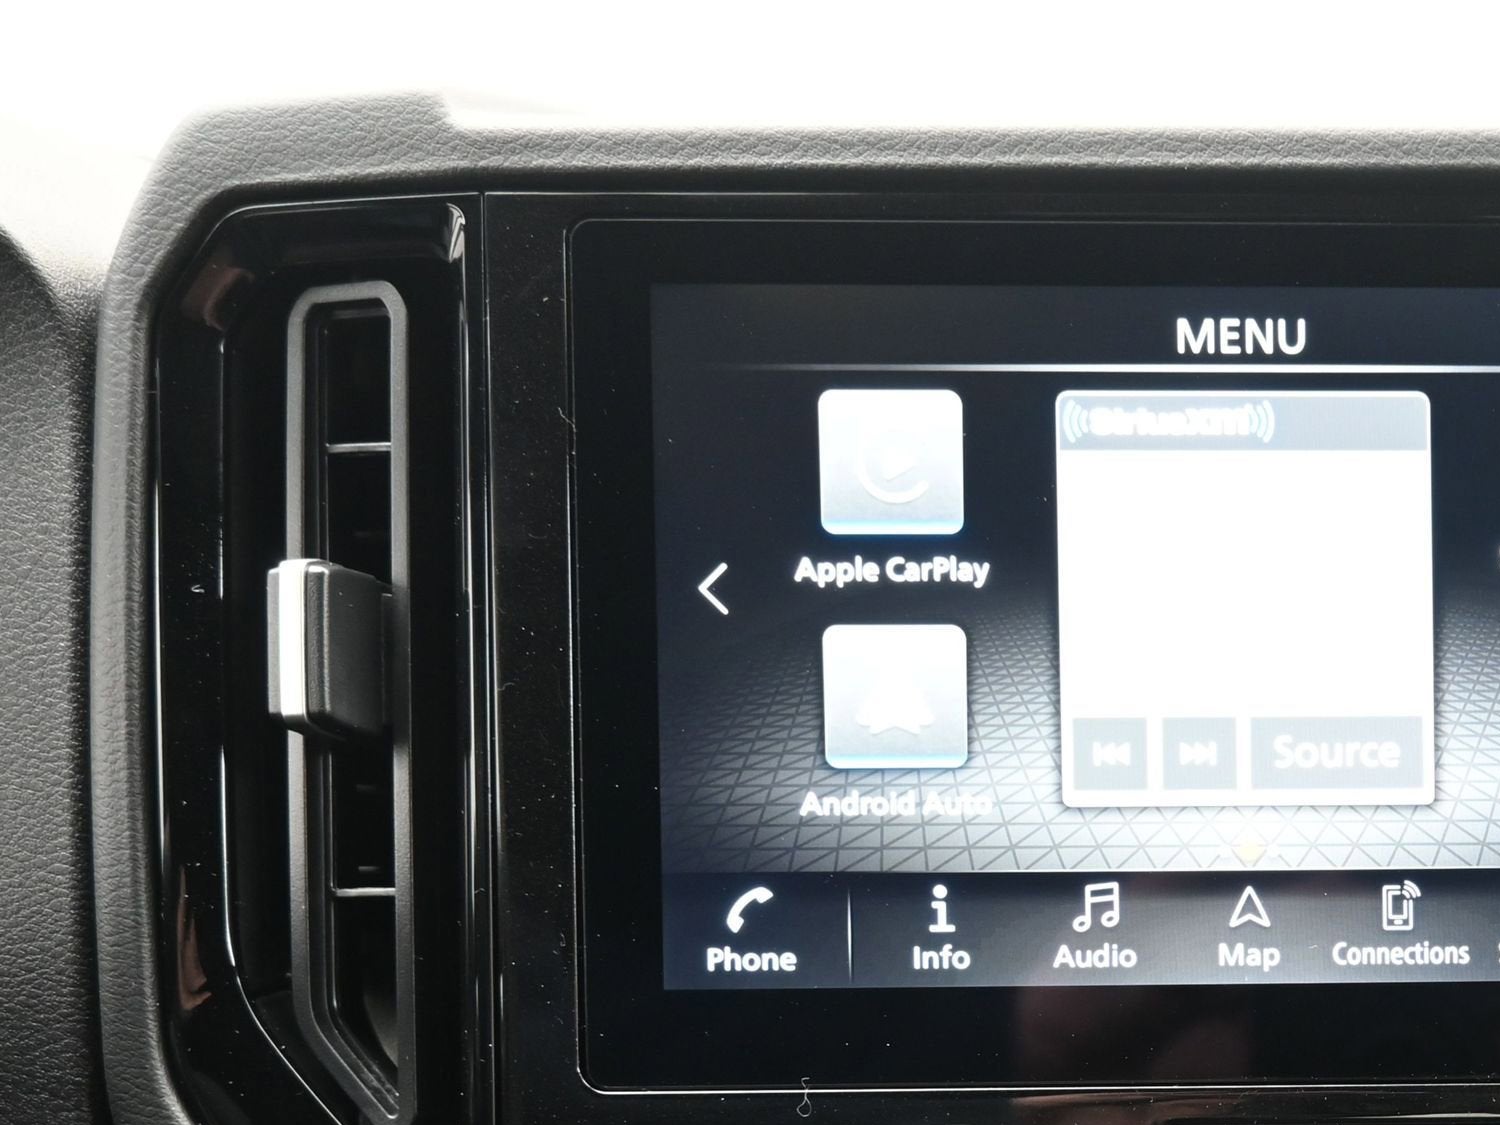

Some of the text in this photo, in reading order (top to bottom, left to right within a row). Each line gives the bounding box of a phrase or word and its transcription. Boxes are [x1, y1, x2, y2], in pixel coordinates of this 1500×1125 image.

[1176, 317, 1307, 356] MENU
[794, 556, 990, 588] Apple CarPlay
[1273, 734, 1401, 770] Source
[800, 790, 993, 817] Android Auto
[706, 947, 797, 973] Phone
[913, 945, 971, 971] Info
[1053, 944, 1138, 969] Audio
[1217, 944, 1281, 971] Map
[1332, 941, 1470, 967] Connections
